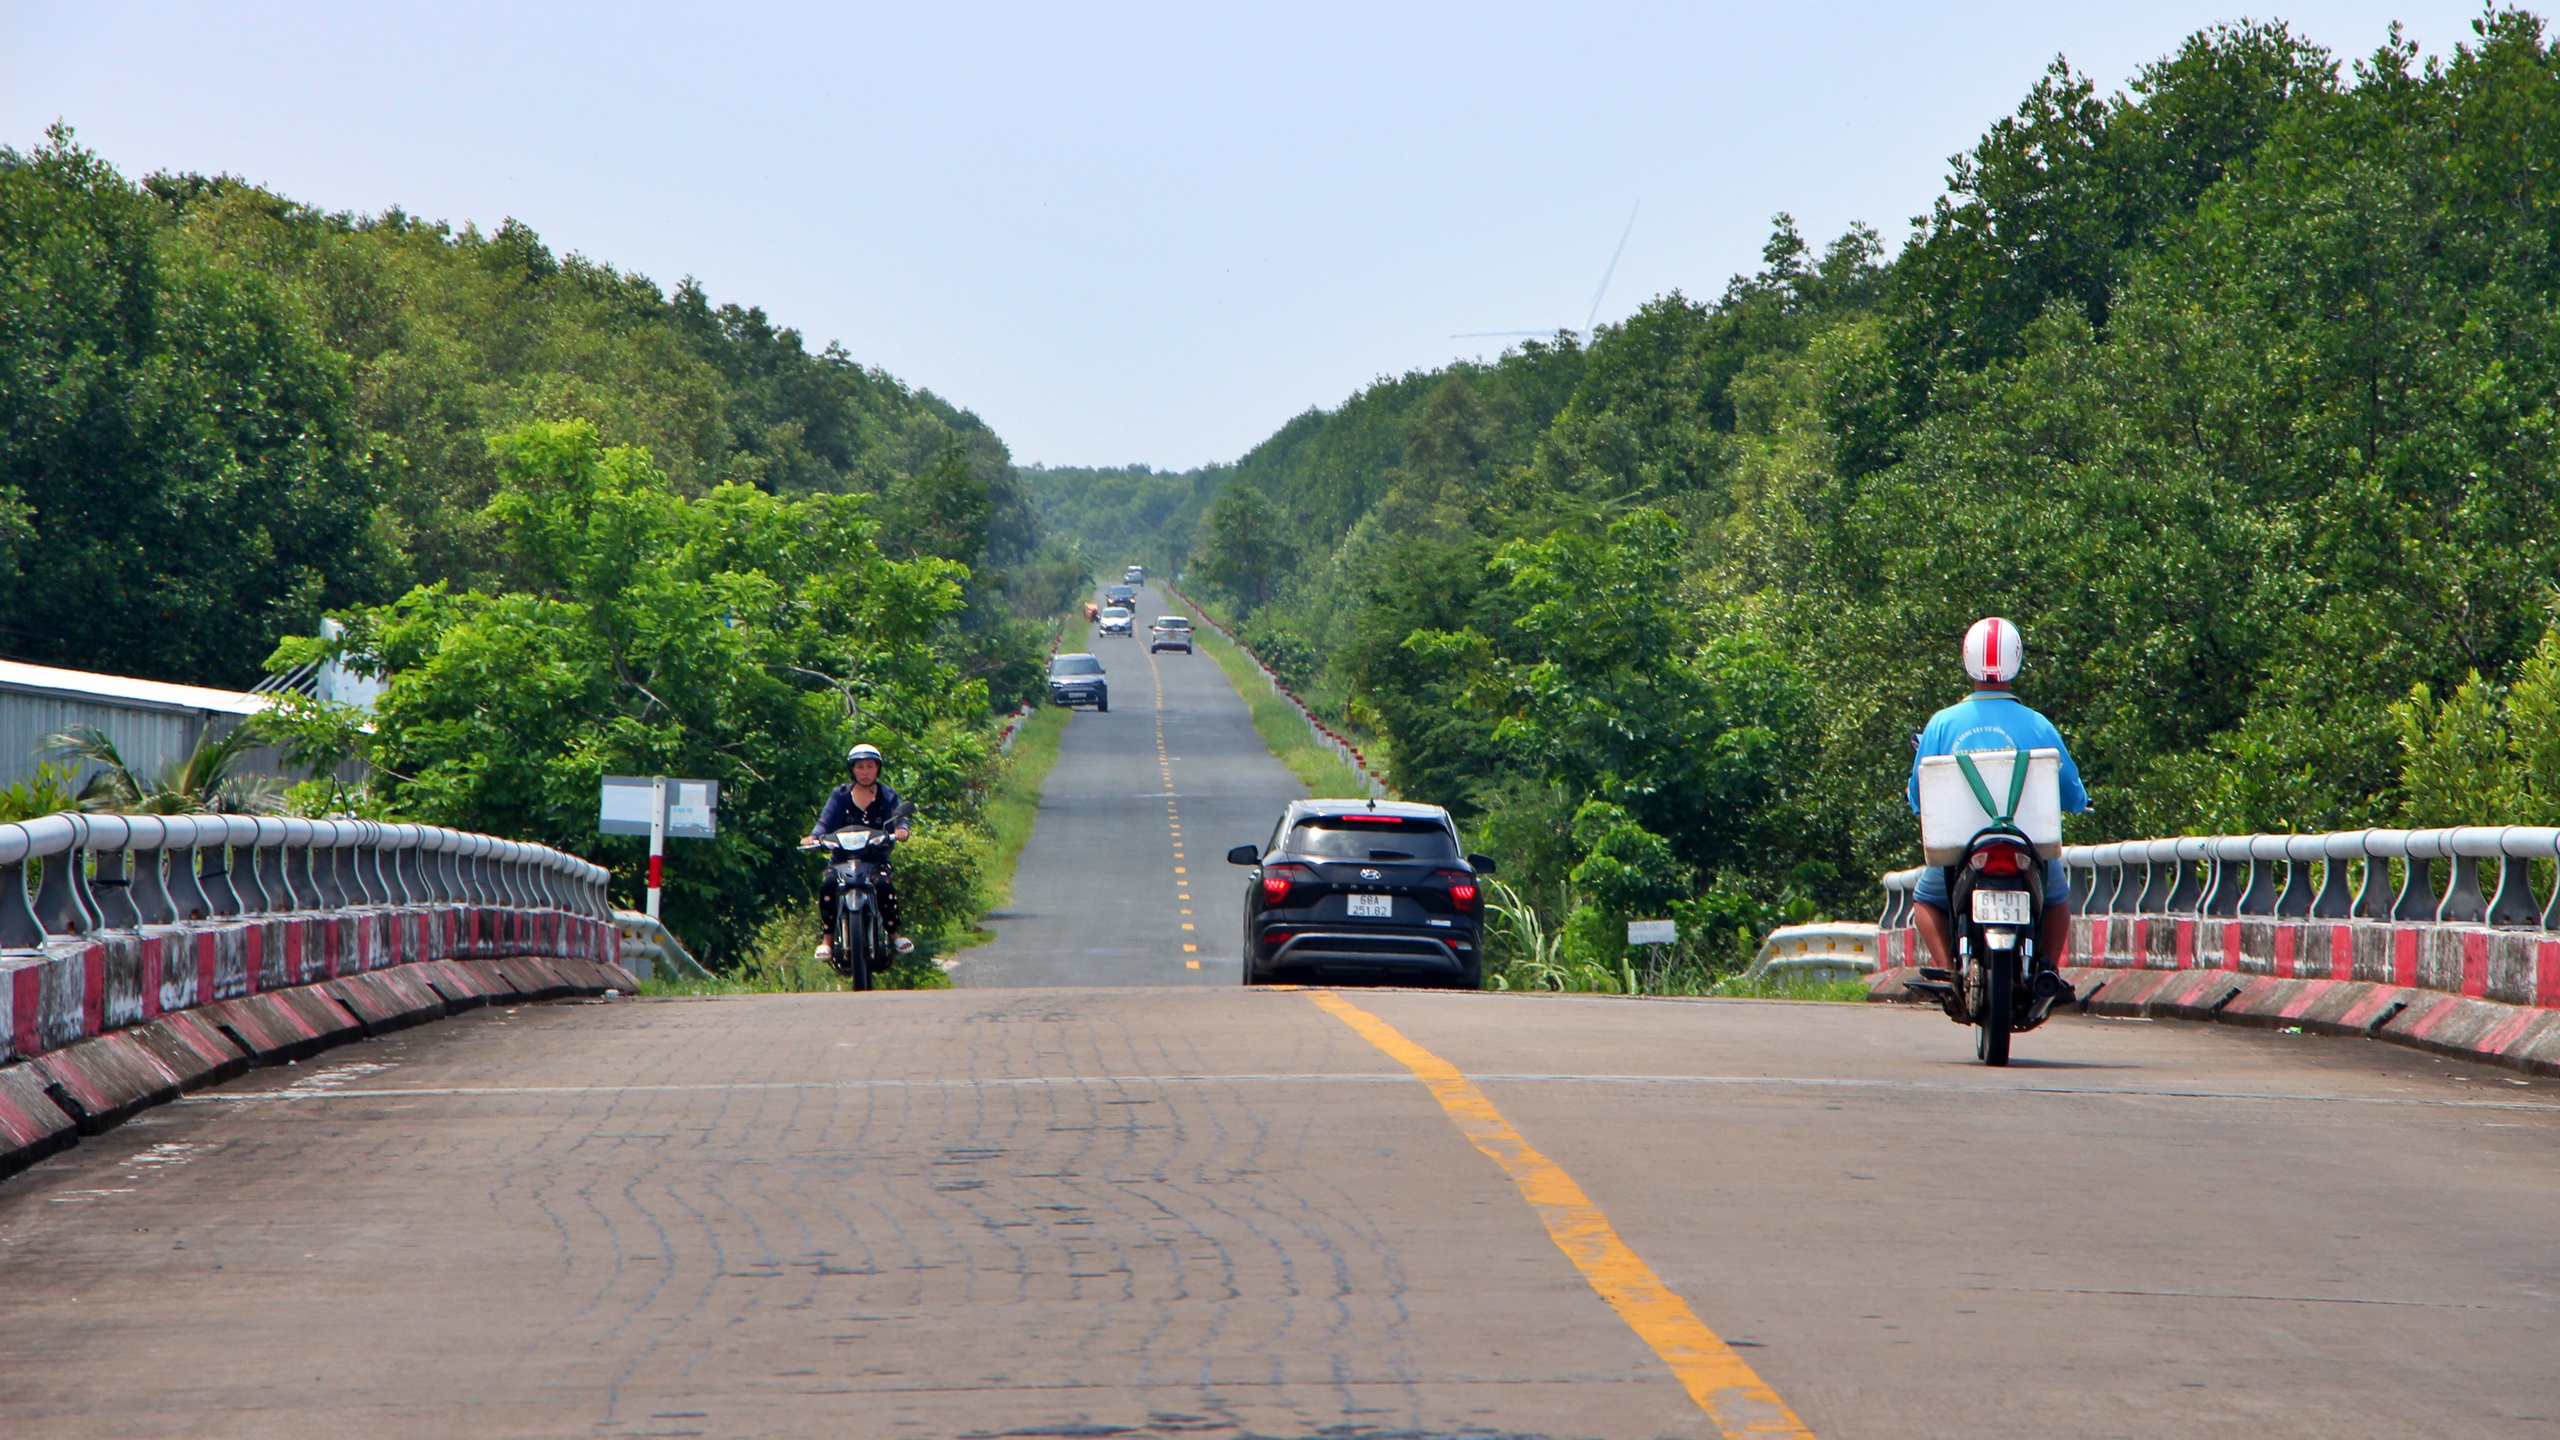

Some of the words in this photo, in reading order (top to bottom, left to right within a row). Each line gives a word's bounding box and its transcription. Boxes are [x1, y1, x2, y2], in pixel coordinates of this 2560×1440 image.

[1332, 883, 1408, 891] CRETA
[1353, 905, 1387, 916] 251.82
[1982, 907, 2020, 921] 8151
